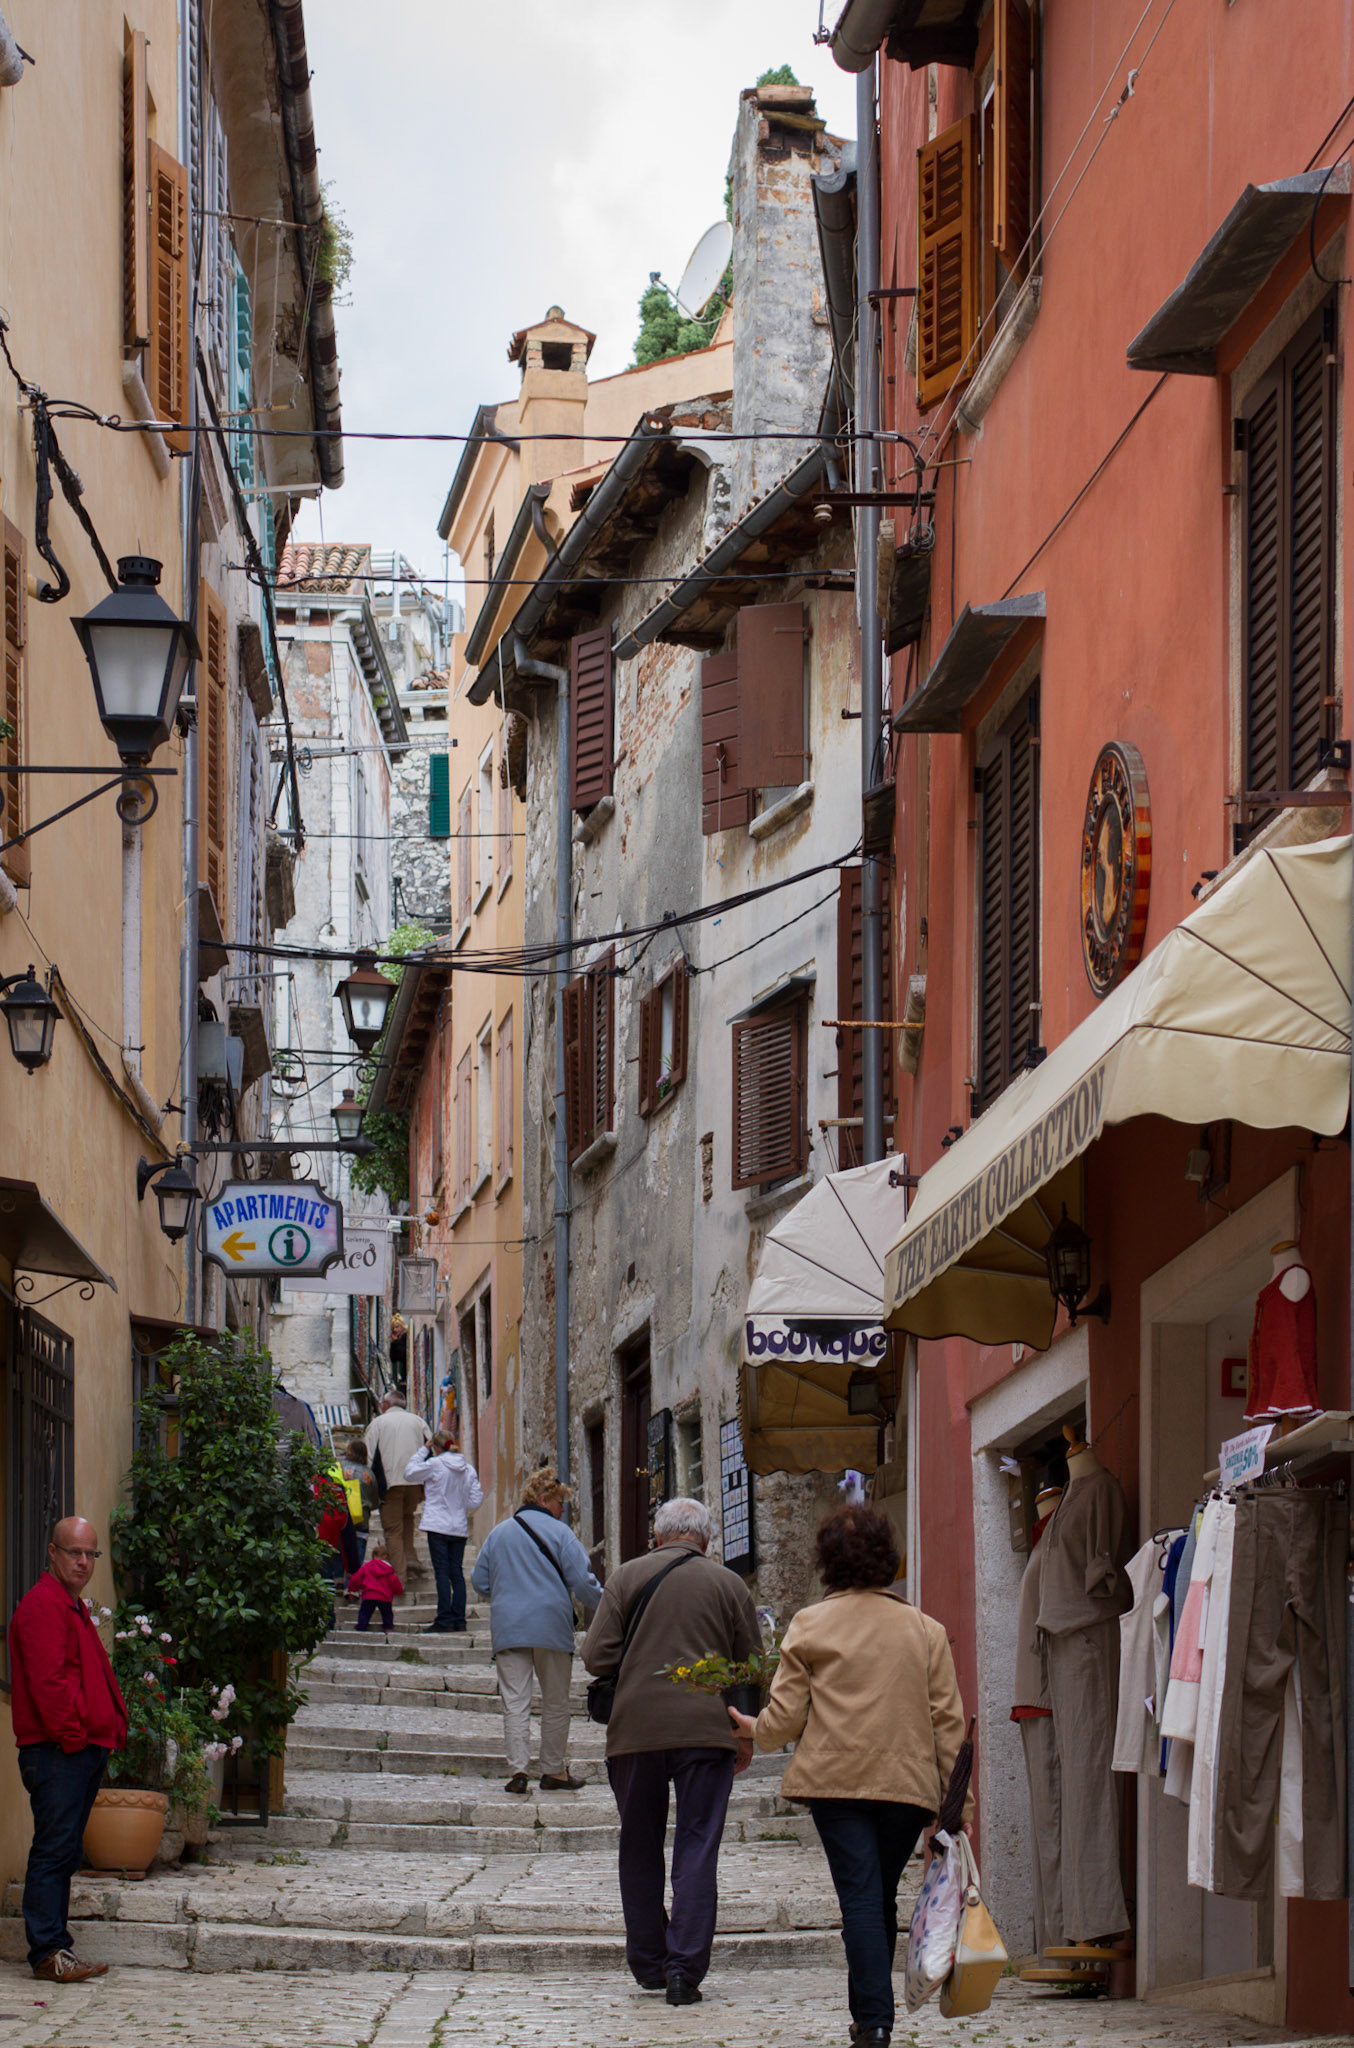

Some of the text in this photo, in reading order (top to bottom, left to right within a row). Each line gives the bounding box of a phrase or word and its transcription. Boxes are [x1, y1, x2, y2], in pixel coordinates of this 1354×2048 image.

[212, 1193, 330, 1230] APARTMENTS
[895, 1065, 1106, 1300] THE EARTH COLLECTION
